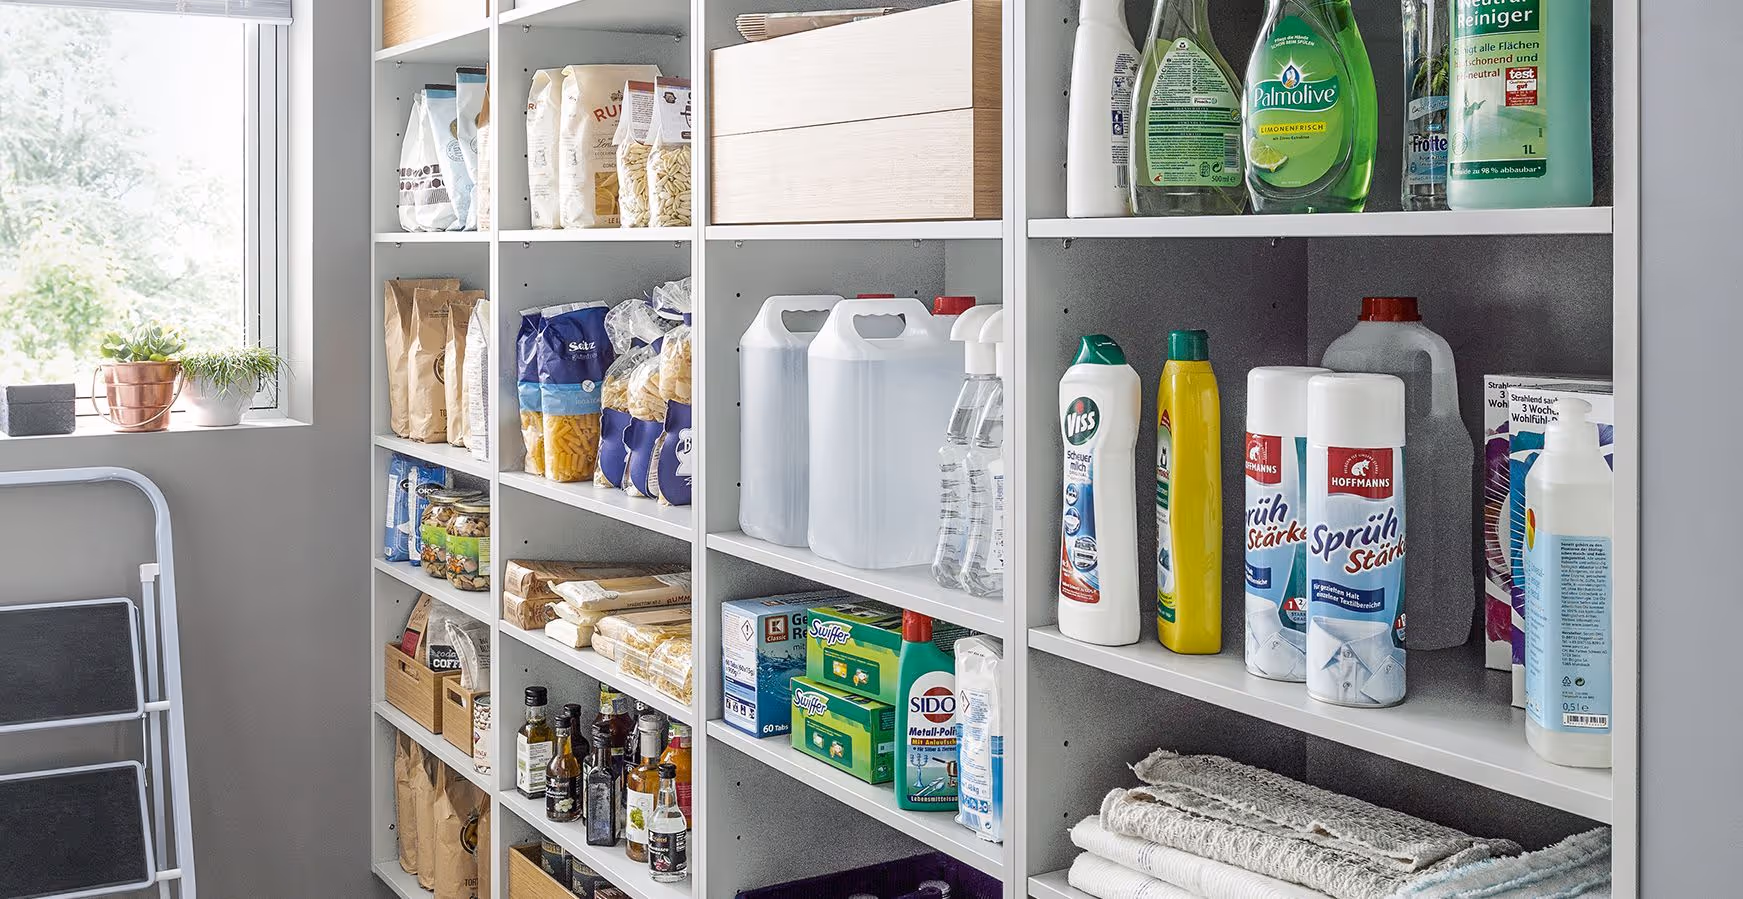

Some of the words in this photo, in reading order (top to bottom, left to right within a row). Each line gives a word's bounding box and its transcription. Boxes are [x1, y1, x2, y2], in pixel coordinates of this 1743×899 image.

[1457, 9, 1533, 28] Reiniger
[1480, 43, 1496, 52] alle
[1499, 41, 1540, 51] Flächen
[1516, 53, 1538, 62] und
[1509, 69, 1535, 80] test
[1254, 84, 1335, 108] Palmolive
[1260, 124, 1324, 133] LIMONENFRISCH
[1500, 390, 1506, 398] 3
[1511, 393, 1543, 404] Strahlend
[1521, 403, 1528, 413] 3
[1529, 404, 1560, 416] Woch
[1067, 402, 1096, 438] Viss
[1067, 450, 1092, 463] Scheuer
[1070, 460, 1087, 472] milch
[1331, 477, 1390, 488] HOFFMANNS
[1246, 493, 1288, 527] rüh
[1247, 521, 1307, 550] Stärke
[1311, 507, 1398, 562] Sprüh
[666, 595, 691, 604] RUMM
[1345, 591, 1360, 600] Halt
[1288, 600, 1293, 610] 1
[1298, 598, 1303, 606] 2
[1340, 596, 1381, 609] Textilbereiche
[771, 620, 781, 632] K
[792, 614, 808, 626] Ge
[767, 634, 786, 642] Classic
[793, 627, 808, 640] Re
[809, 619, 850, 645] Swiffer
[794, 689, 827, 716] Swiffer
[910, 696, 956, 713] SIDO
[1562, 702, 1575, 712] 0,5
[763, 724, 774, 733] 60
[775, 724, 789, 732] Tabs
